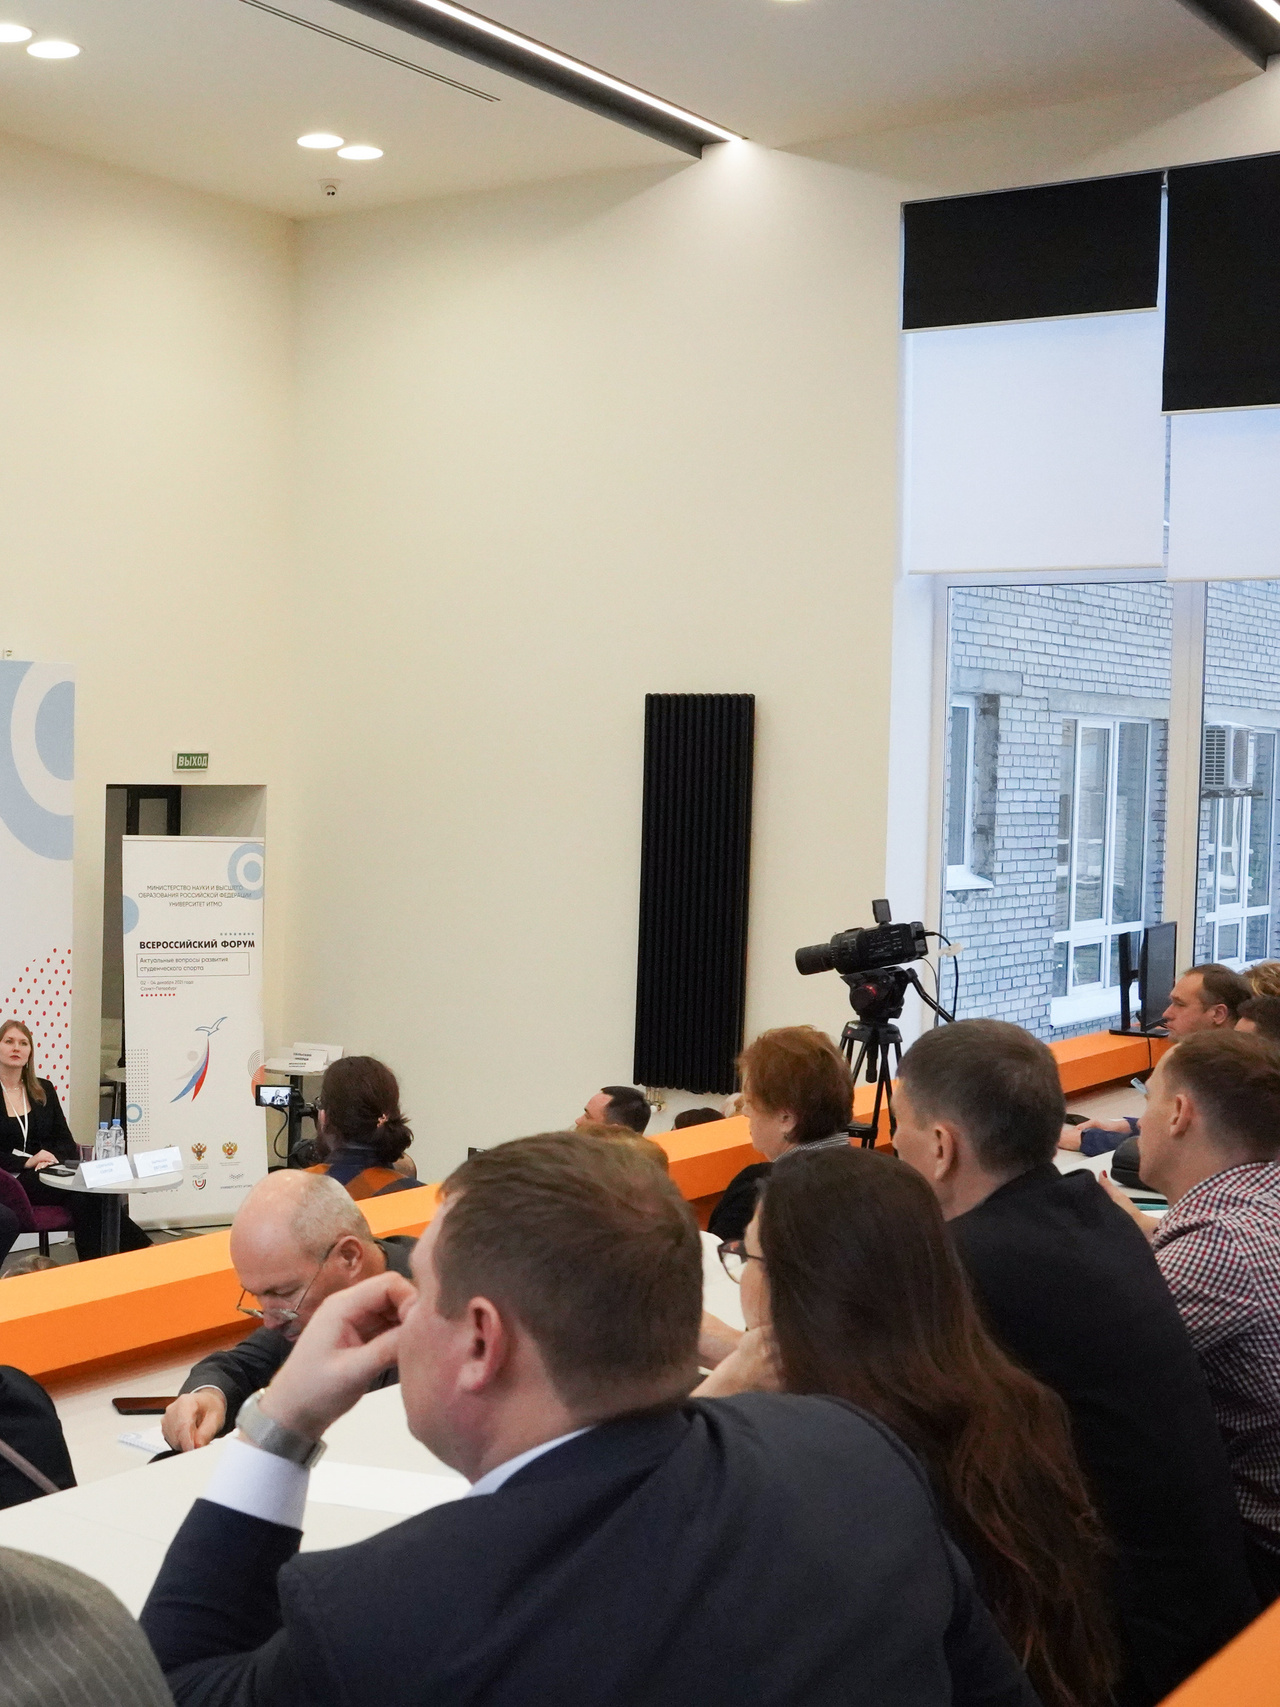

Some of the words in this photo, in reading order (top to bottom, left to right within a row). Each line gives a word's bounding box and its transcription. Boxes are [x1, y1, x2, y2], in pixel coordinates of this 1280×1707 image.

[178, 756, 207, 767] ВЫХОД
[140, 939, 217, 949] ВСЕРОССИЙСКИЙ
[221, 940, 255, 949] ФОРУМ
